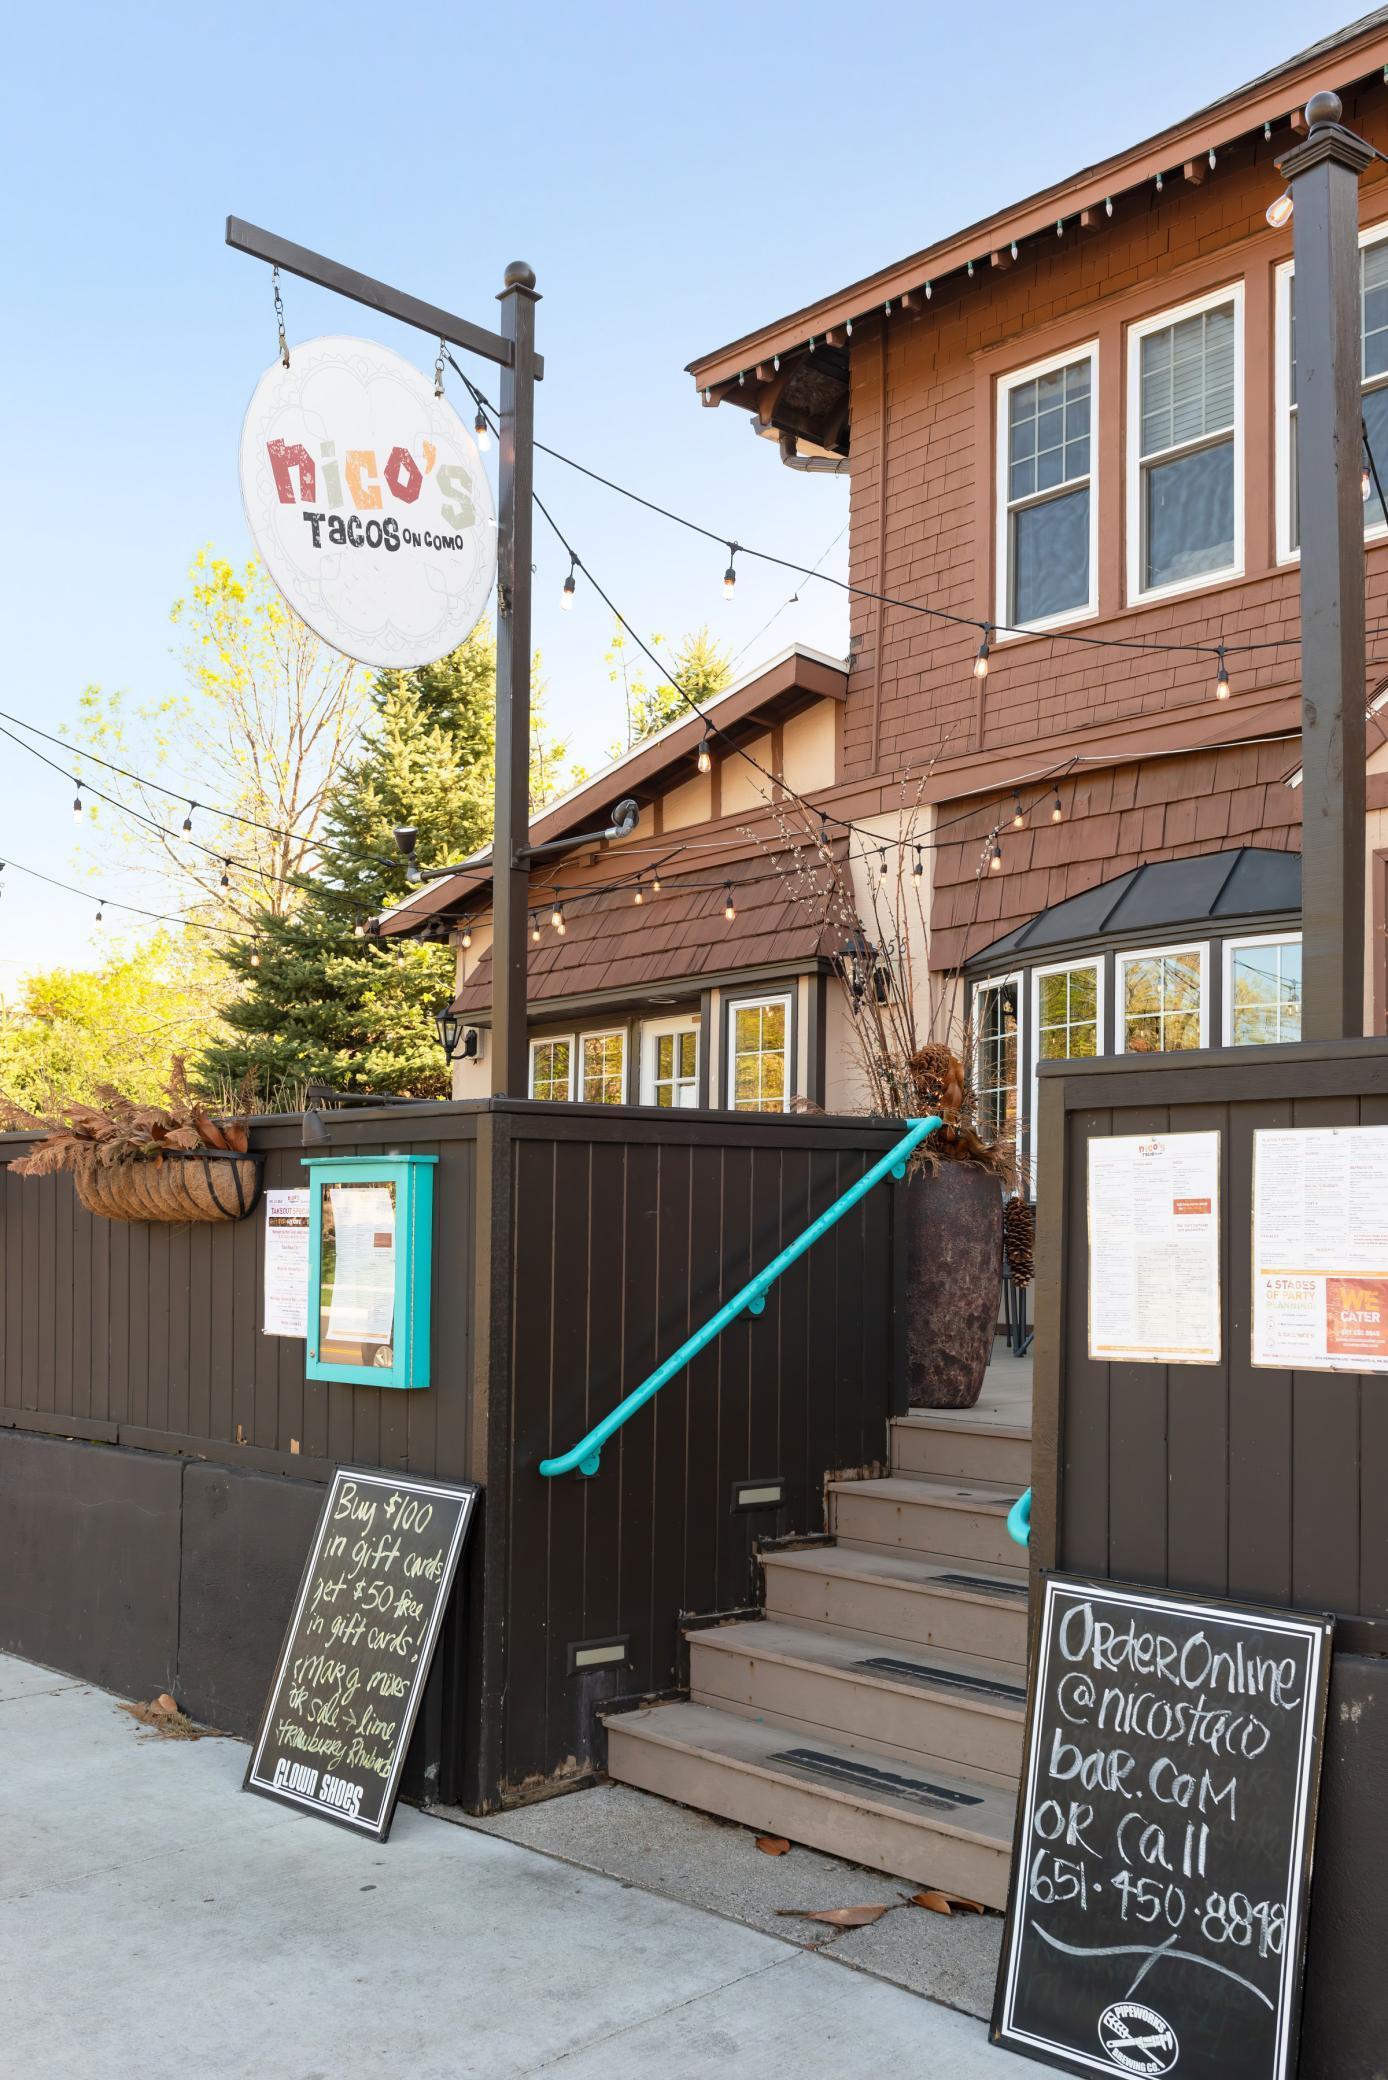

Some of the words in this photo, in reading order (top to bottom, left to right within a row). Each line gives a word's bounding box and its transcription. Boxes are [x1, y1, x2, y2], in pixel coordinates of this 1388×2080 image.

[403, 528, 422, 548] ON
[424, 531, 464, 551] COMO
[1275, 1279, 1316, 1290] STAGES
[1340, 1283, 1380, 1311] WE
[1340, 1311, 1380, 1323] CATER
[334, 1483, 377, 1537] Buy
[384, 1491, 433, 1534] $100
[323, 1528, 347, 1560] in
[348, 1534, 402, 1579] gift
[353, 1577, 394, 1613] $50
[306, 1611, 324, 1635] in
[324, 1612, 366, 1648] gift
[1113, 2005, 1167, 2034] PIPEWORKS
[1111, 2047, 1147, 2073] BREWING
[1146, 2062, 1161, 2073] CO.
